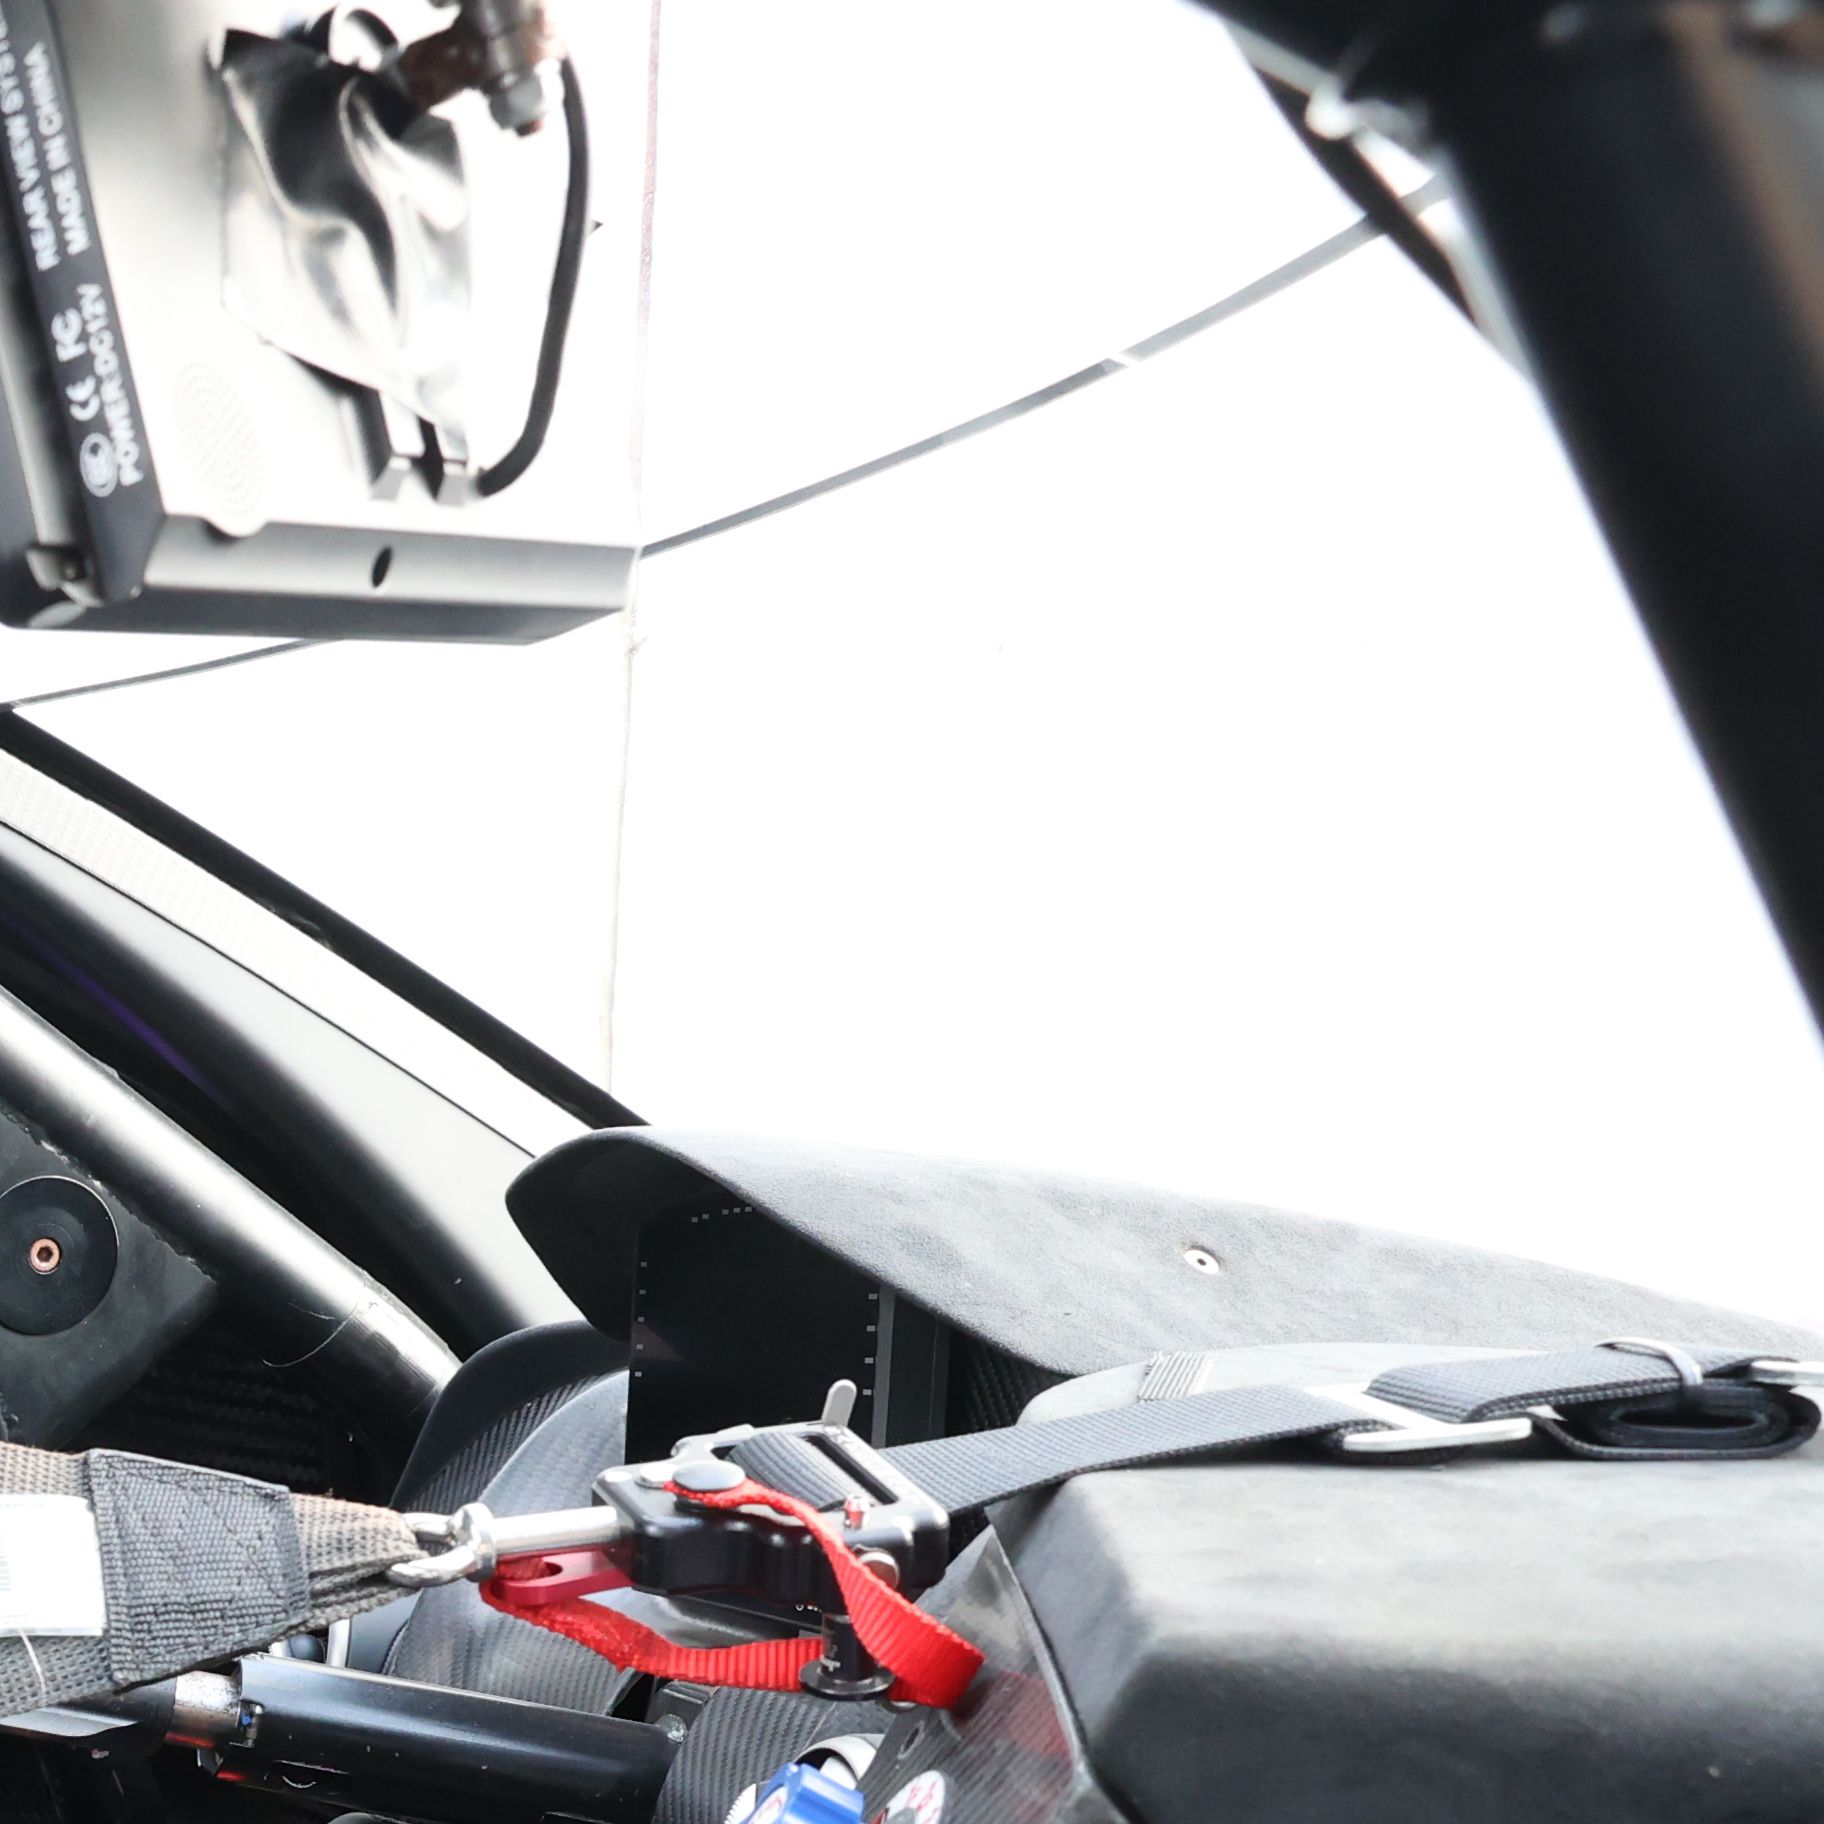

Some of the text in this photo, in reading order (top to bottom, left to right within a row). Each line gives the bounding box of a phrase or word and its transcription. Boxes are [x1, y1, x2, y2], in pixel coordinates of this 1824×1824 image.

[24, 41, 91, 256] MADE IN CHINA
[22, 186, 61, 272] REAR
